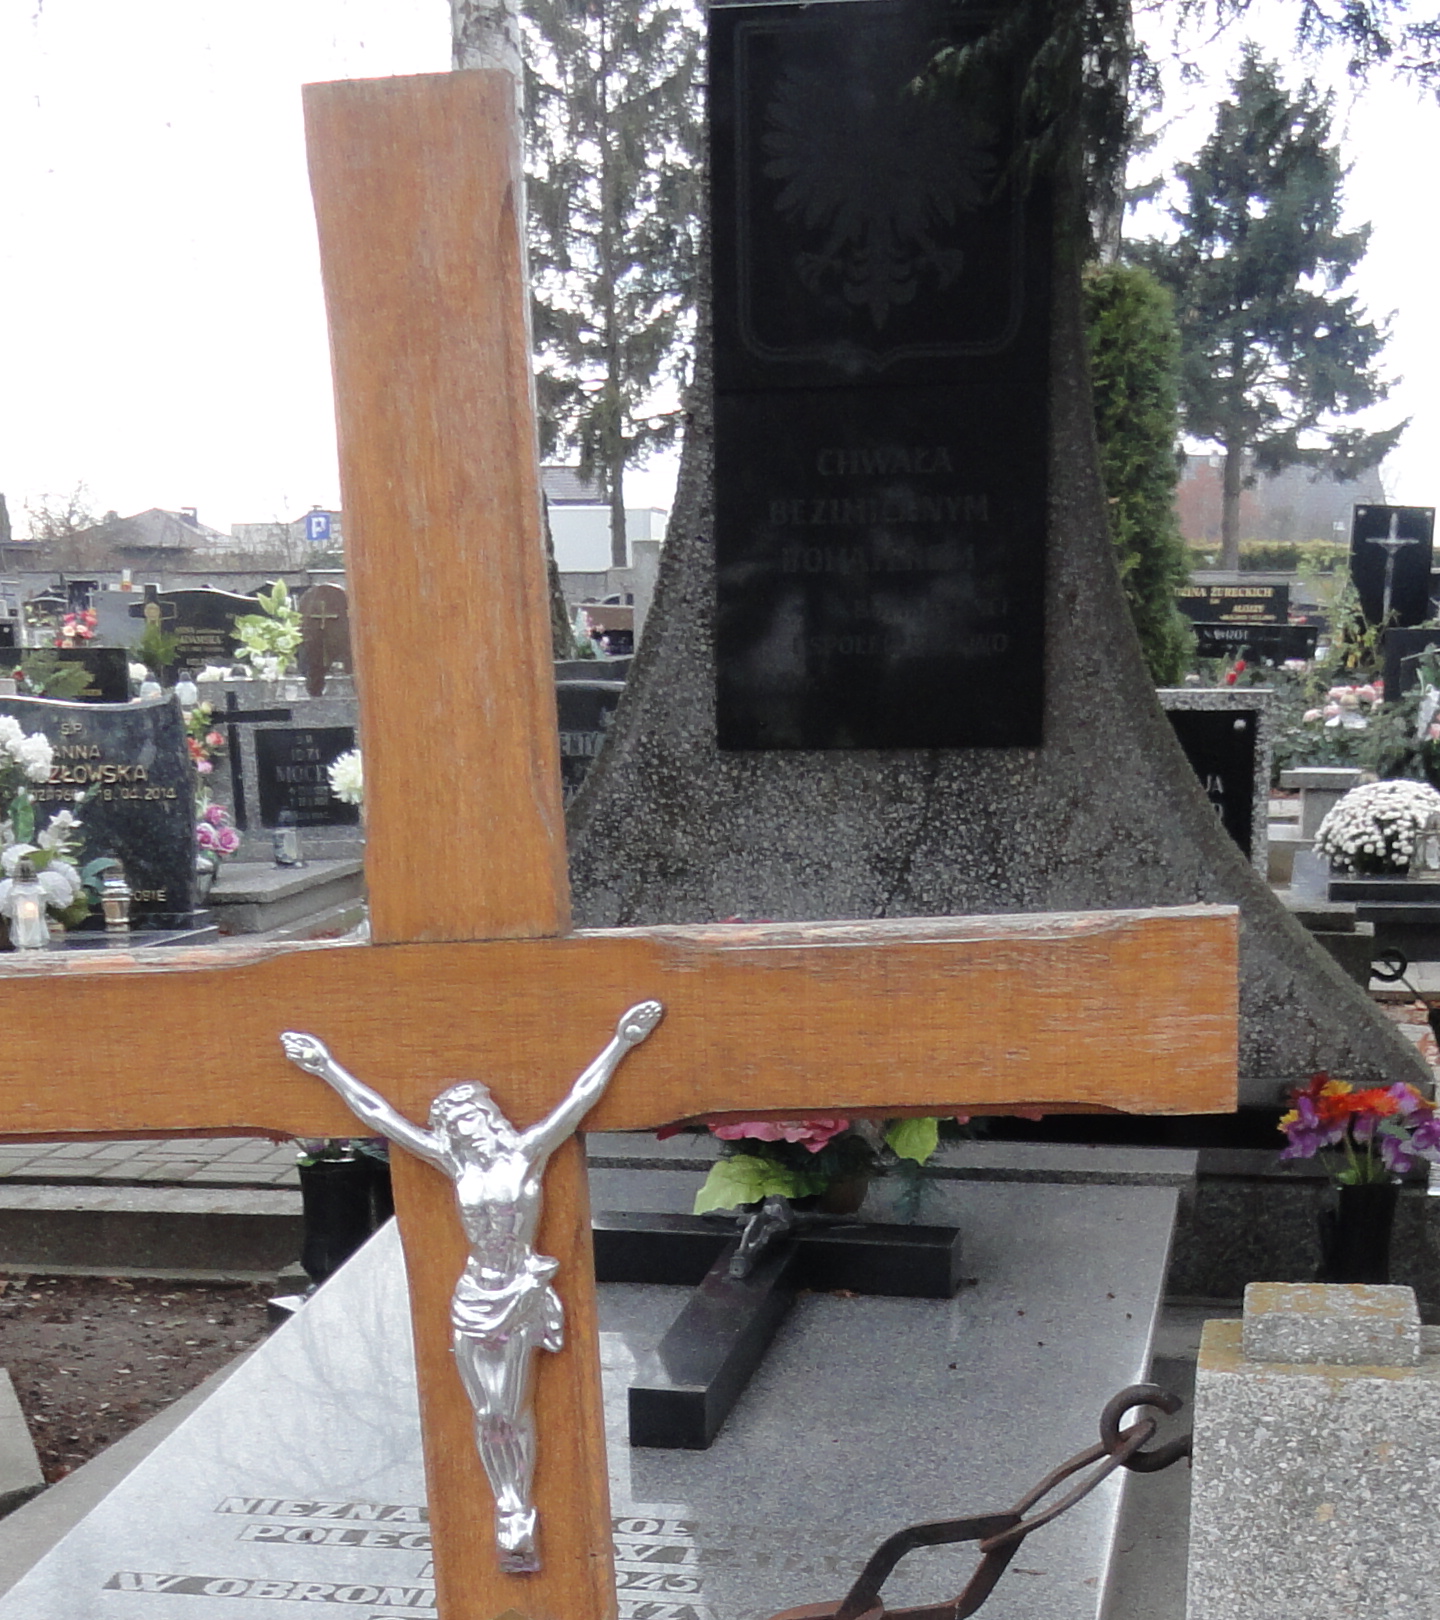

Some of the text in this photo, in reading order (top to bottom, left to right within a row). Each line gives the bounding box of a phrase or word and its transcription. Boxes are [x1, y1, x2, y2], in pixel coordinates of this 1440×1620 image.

[816, 446, 954, 476] CHWAŁA
[311, 517, 326, 538] P
[53, 744, 101, 760] ANNA
[215, 1496, 430, 1523] NIEZNA
[241, 1522, 434, 1551] POLEG
[116, 1571, 436, 1609] W OBRONI
